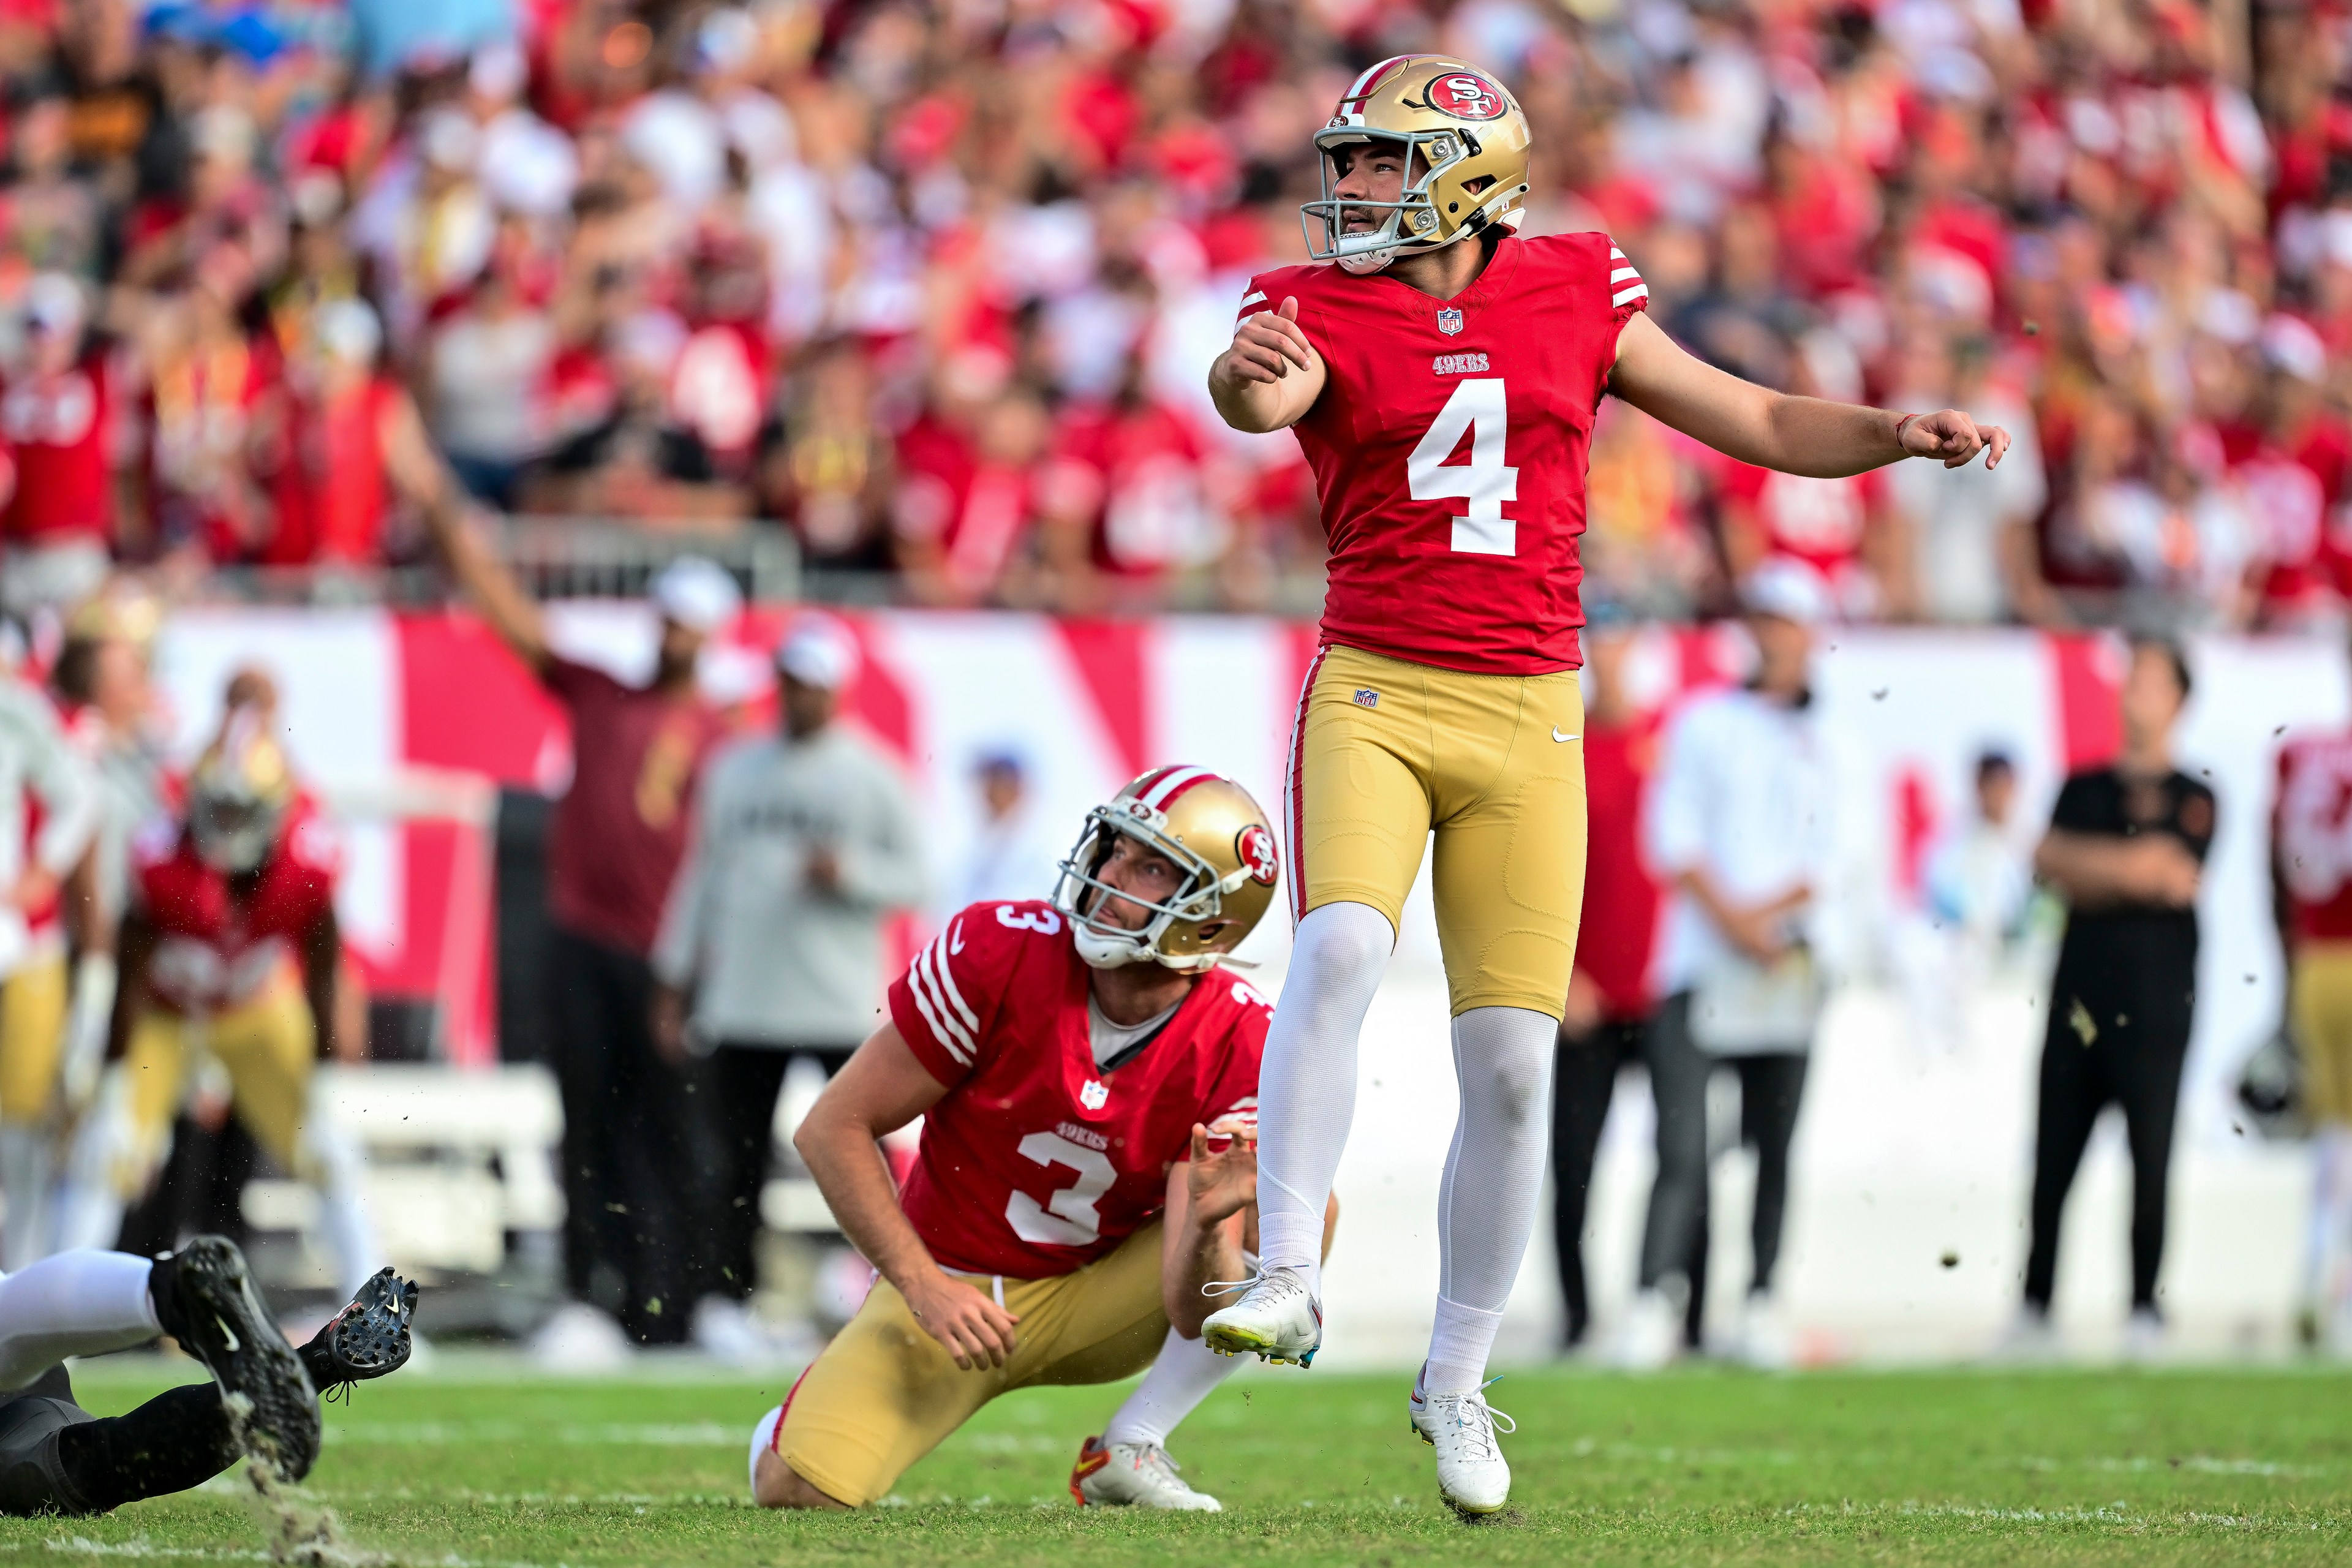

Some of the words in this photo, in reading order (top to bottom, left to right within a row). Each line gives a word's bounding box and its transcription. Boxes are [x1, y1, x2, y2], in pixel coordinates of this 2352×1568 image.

[1442, 318, 1460, 331] NFL
[1432, 353, 1490, 375] 49ERS
[1407, 378, 1520, 557] 4
[995, 905, 1061, 935] 3
[1005, 1130, 1118, 1246] 3
